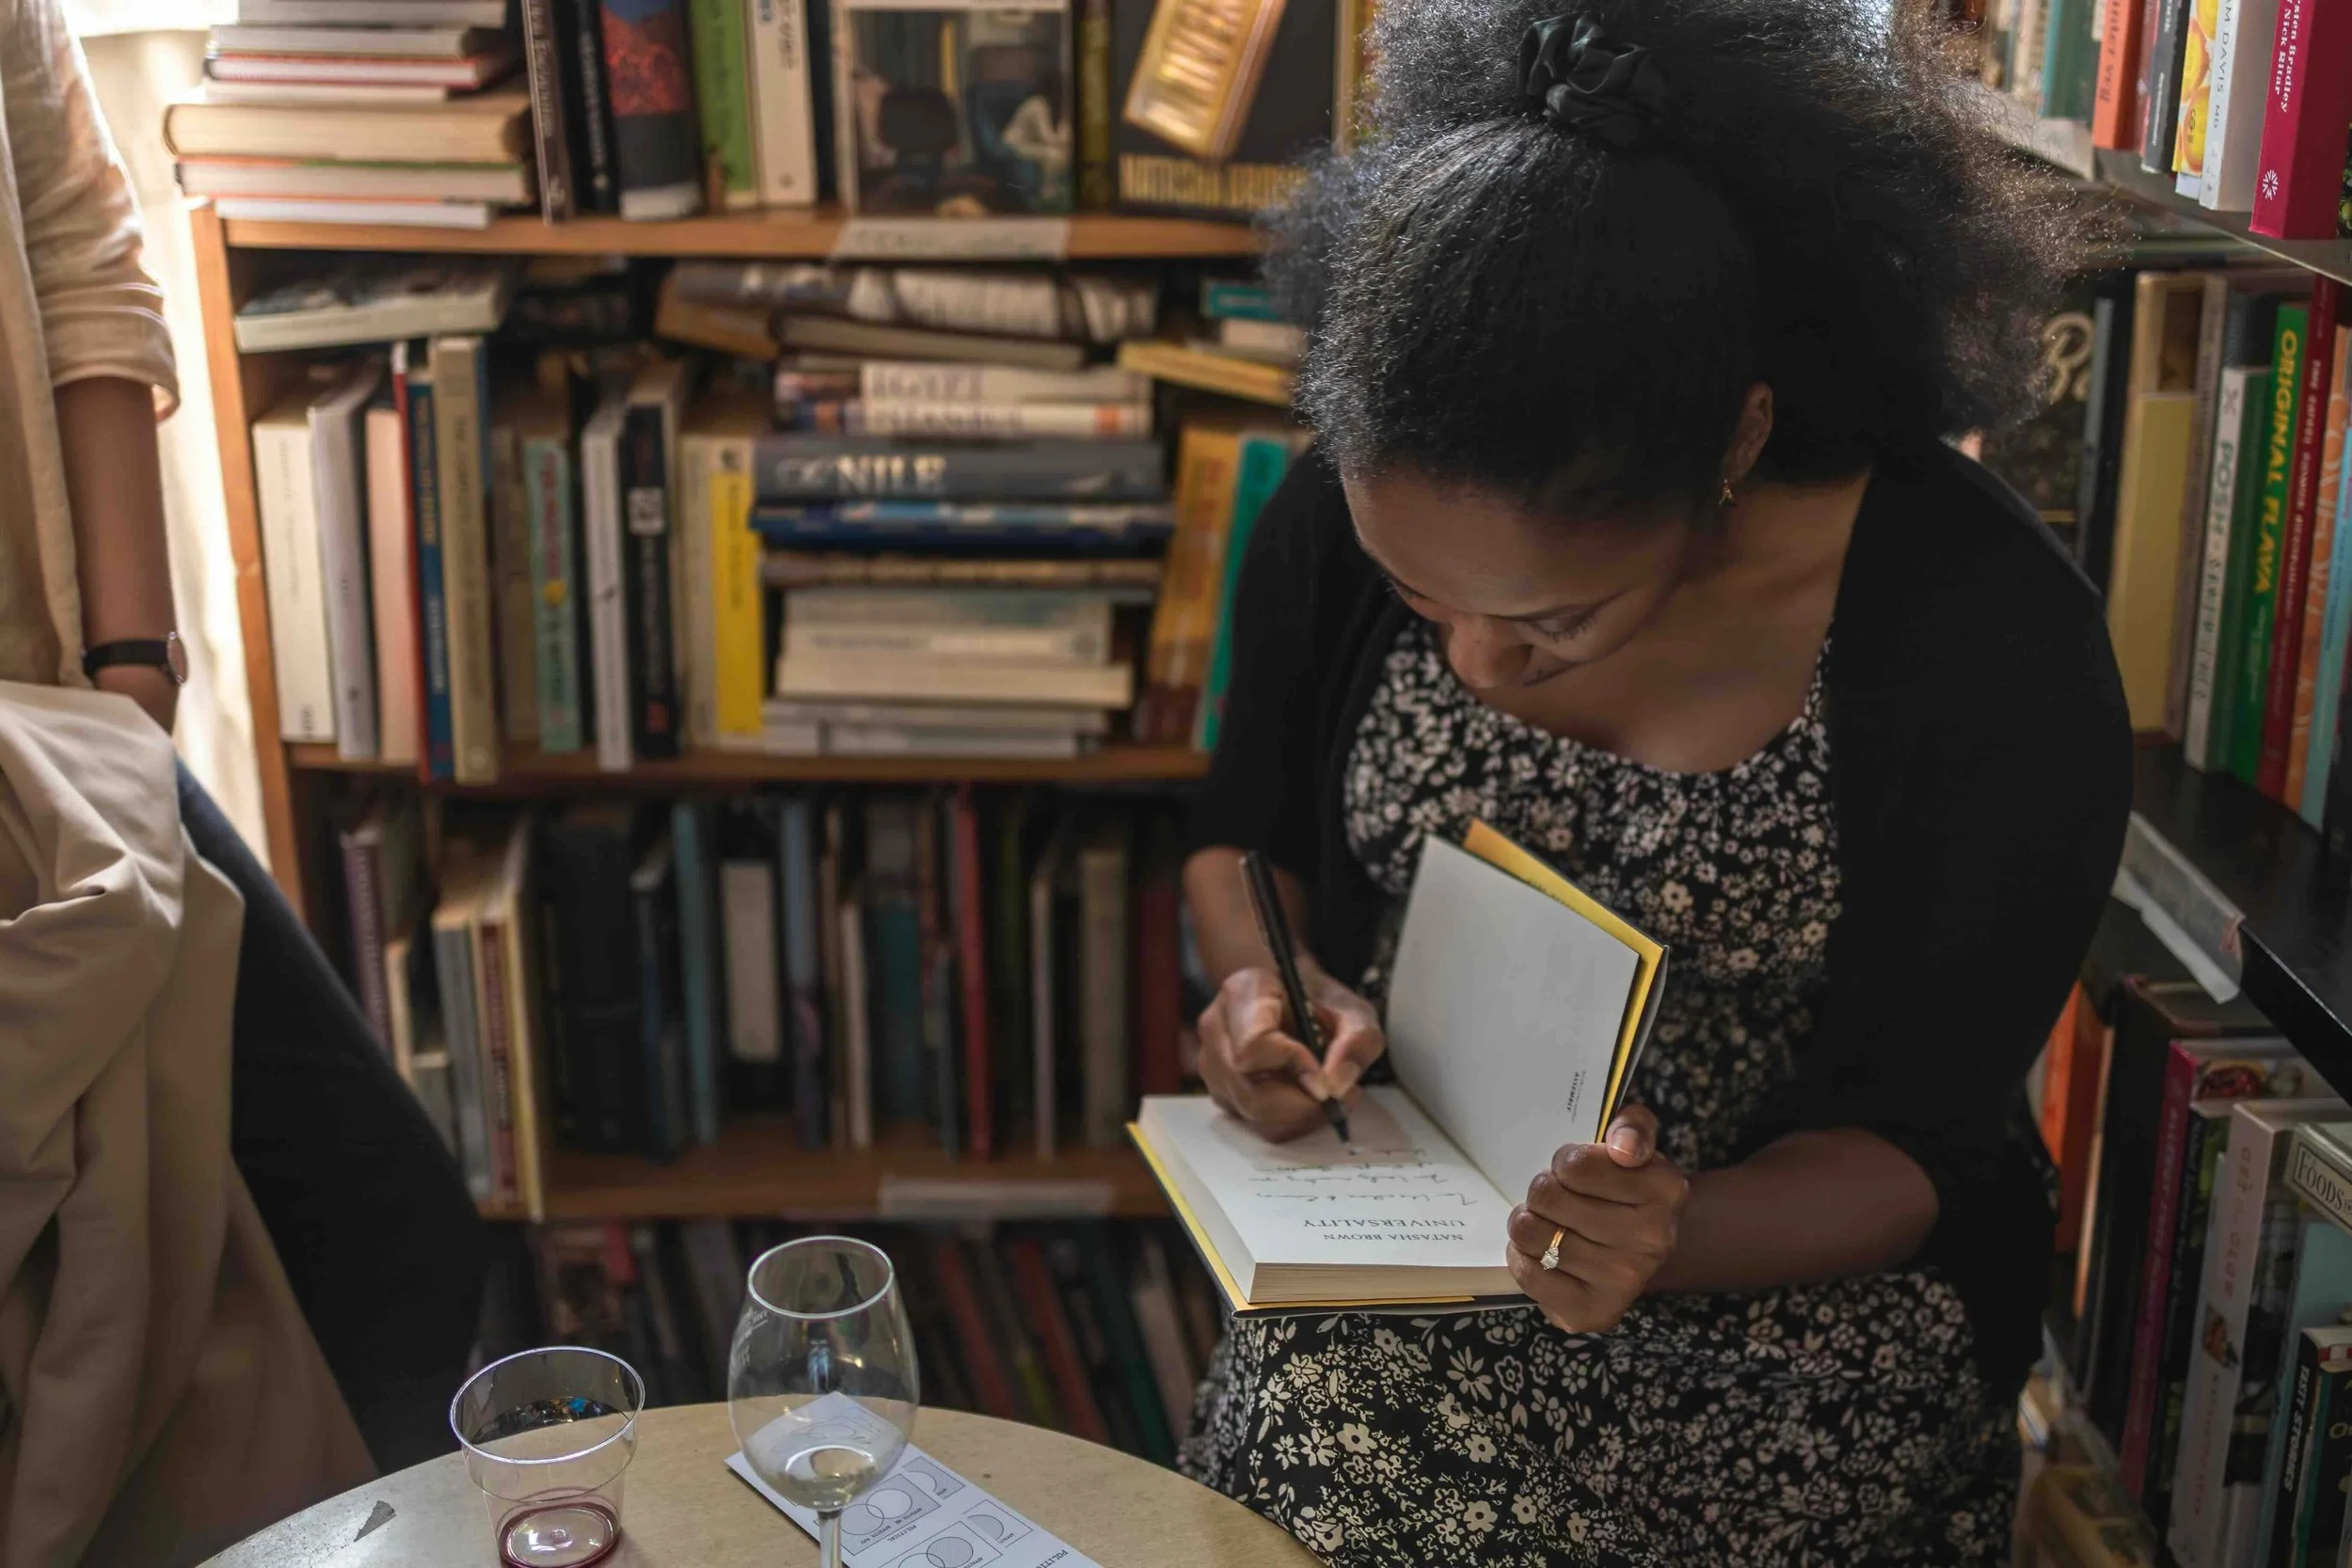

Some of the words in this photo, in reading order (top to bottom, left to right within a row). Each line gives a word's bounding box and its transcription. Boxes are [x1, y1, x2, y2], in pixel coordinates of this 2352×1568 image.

[2280, 8, 2293, 46] Nick
[2290, 0, 2301, 40] sten
[2273, 52, 2286, 95] Ritar
[2280, 44, 2296, 114] Bradley
[2265, 328, 2298, 485] ORIGINAL
[836, 454, 947, 495] NILE
[2253, 496, 2283, 594] FLAVA
[2297, 1150, 2344, 1211] FOODS
[1303, 1218, 1466, 1227] UNIVERSALITY
[1388, 1233, 1464, 1242] NATASHA
[2295, 1363, 2310, 1409] TASTY
[2283, 1409, 2303, 1492] STORIES
